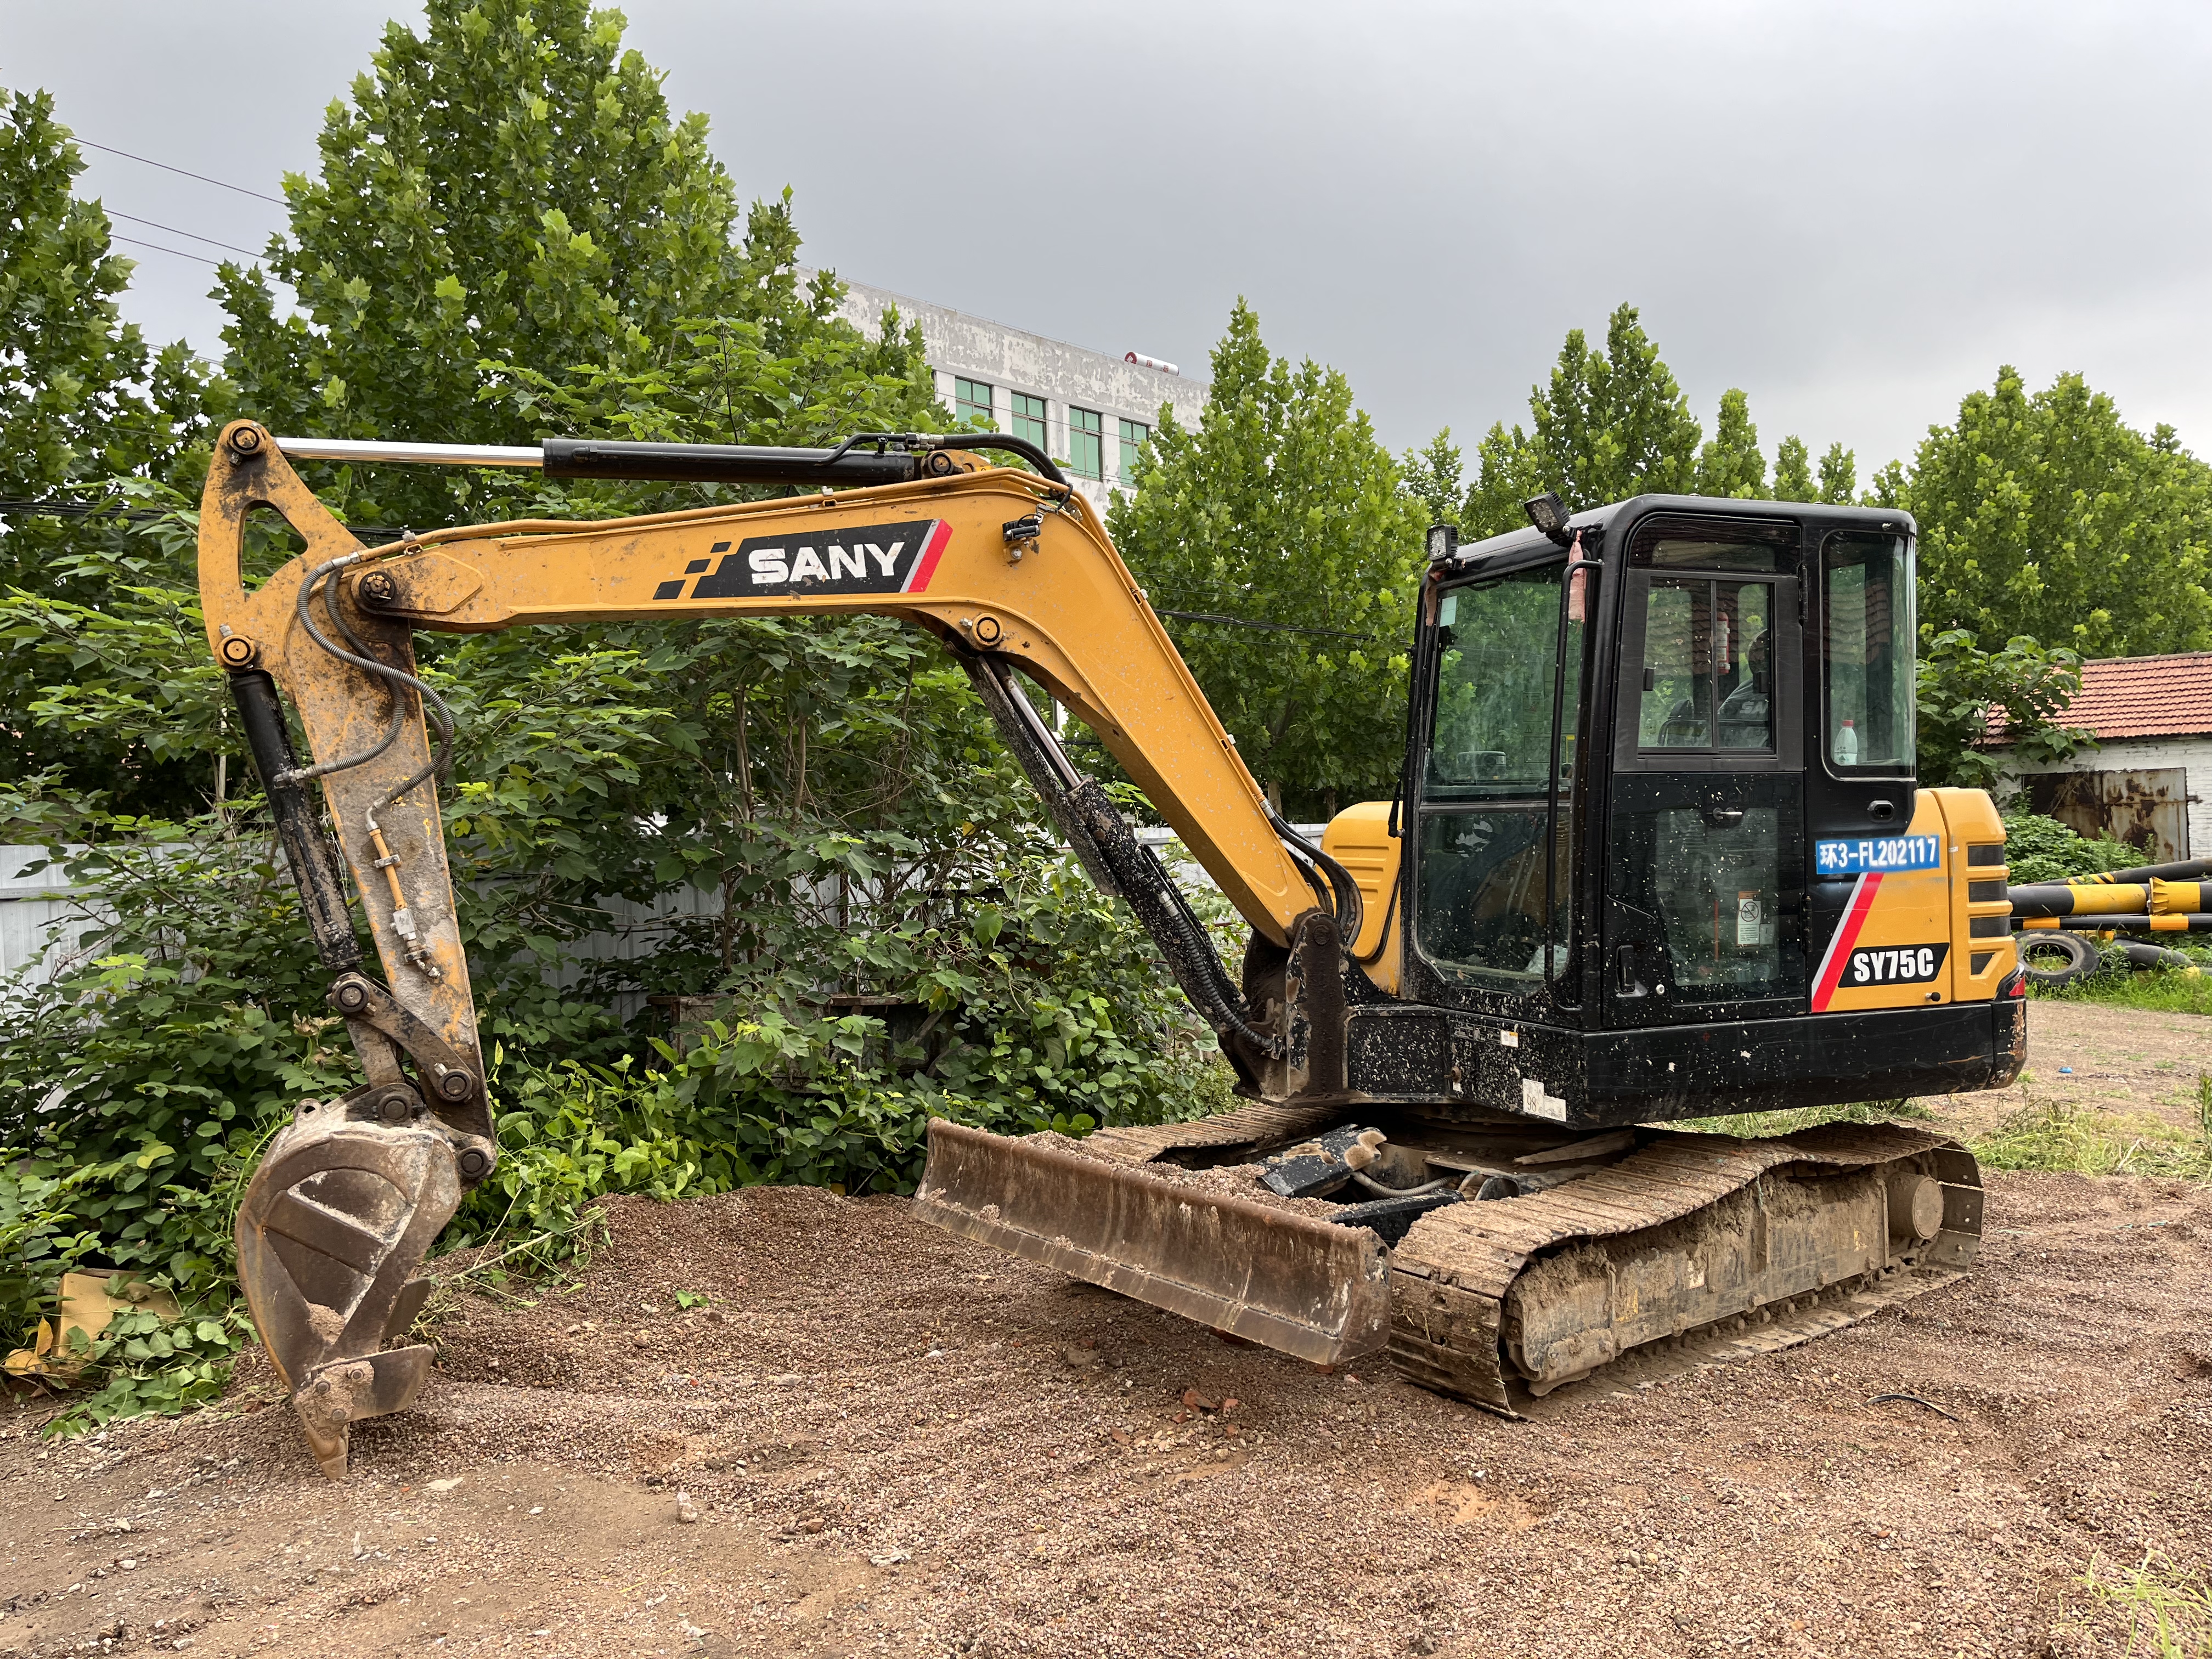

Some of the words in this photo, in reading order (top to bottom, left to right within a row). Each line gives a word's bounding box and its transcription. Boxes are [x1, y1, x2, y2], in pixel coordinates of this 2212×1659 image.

[748, 541, 905, 584] SANY
[1740, 701, 1769, 714] SA
[1819, 838, 1937, 868] 环3-FL202117
[1853, 948, 1934, 982] SY75C
[1527, 1094, 1537, 1112] 98
